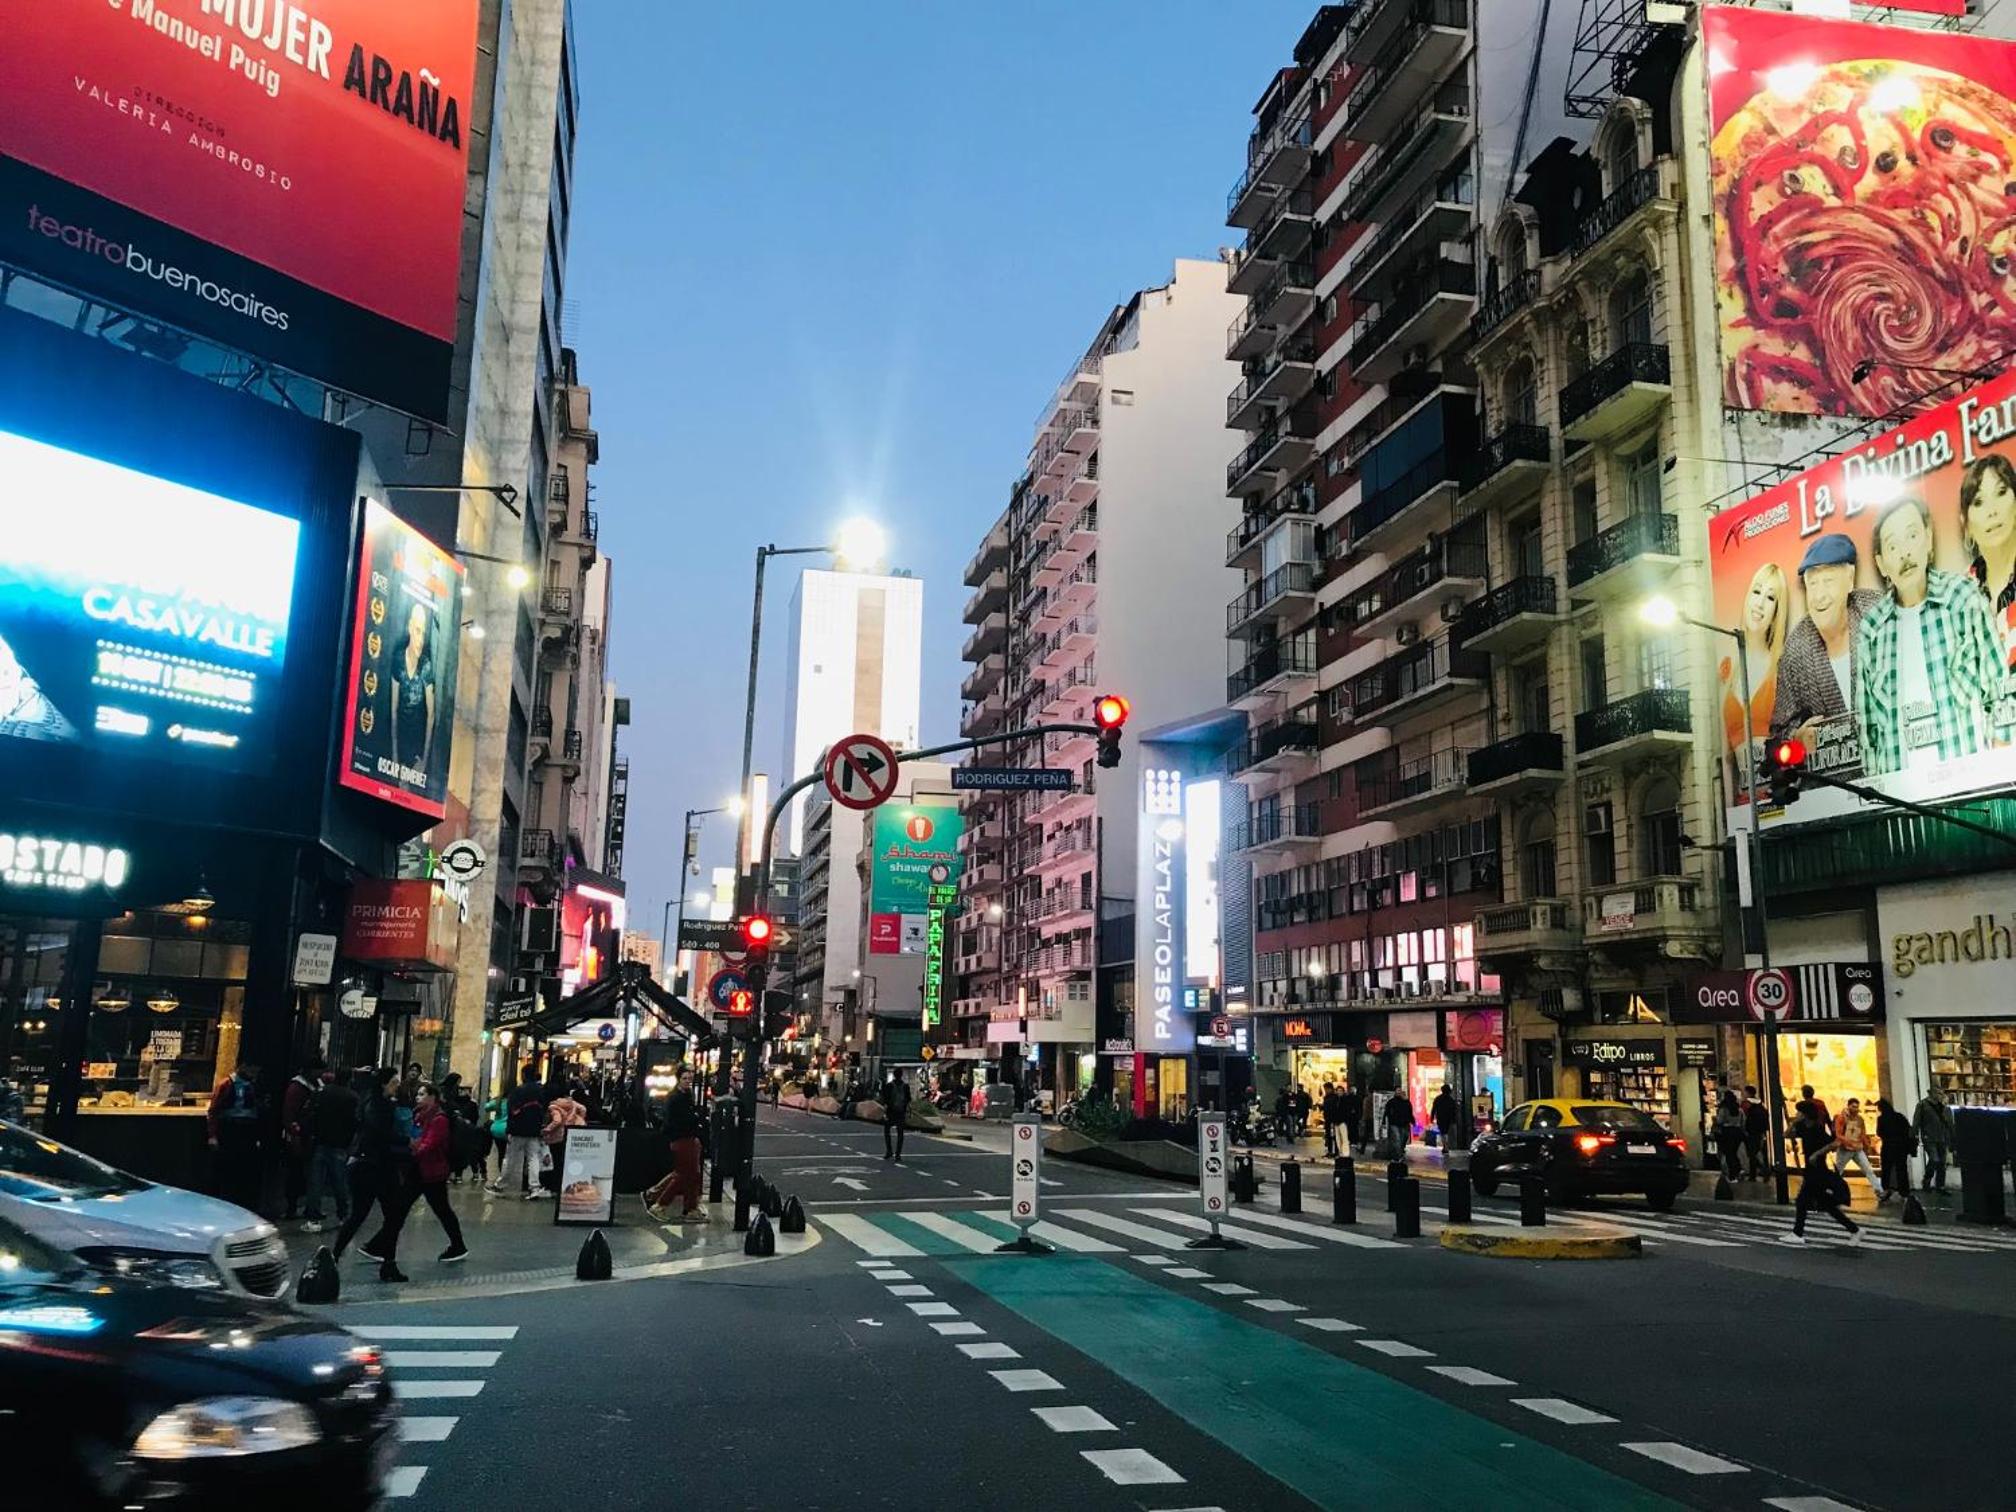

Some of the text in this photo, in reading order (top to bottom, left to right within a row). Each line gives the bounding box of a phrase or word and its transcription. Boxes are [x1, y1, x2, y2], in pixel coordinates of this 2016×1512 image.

[131, 0, 222, 63] Manuel
[230, 44, 280, 98] Puig
[343, 43, 461, 150] ARAÑA
[74, 75, 292, 191] VALERIA AMBROSIO
[28, 204, 289, 331] teatrobuenosaires
[1797, 479, 1836, 537] La
[1843, 427, 1953, 518] Divina
[82, 587, 275, 657] CASAVALLE
[956, 771, 1068, 785] RODRIGUEZ PEÑA
[352, 905, 422, 919] PRIMICIA
[356, 929, 415, 939] CORRIENTES
[1760, 983, 1783, 1000] 30
[1592, 1042, 1626, 1063] Edipo
[1629, 1052, 1655, 1062] LIBROS
